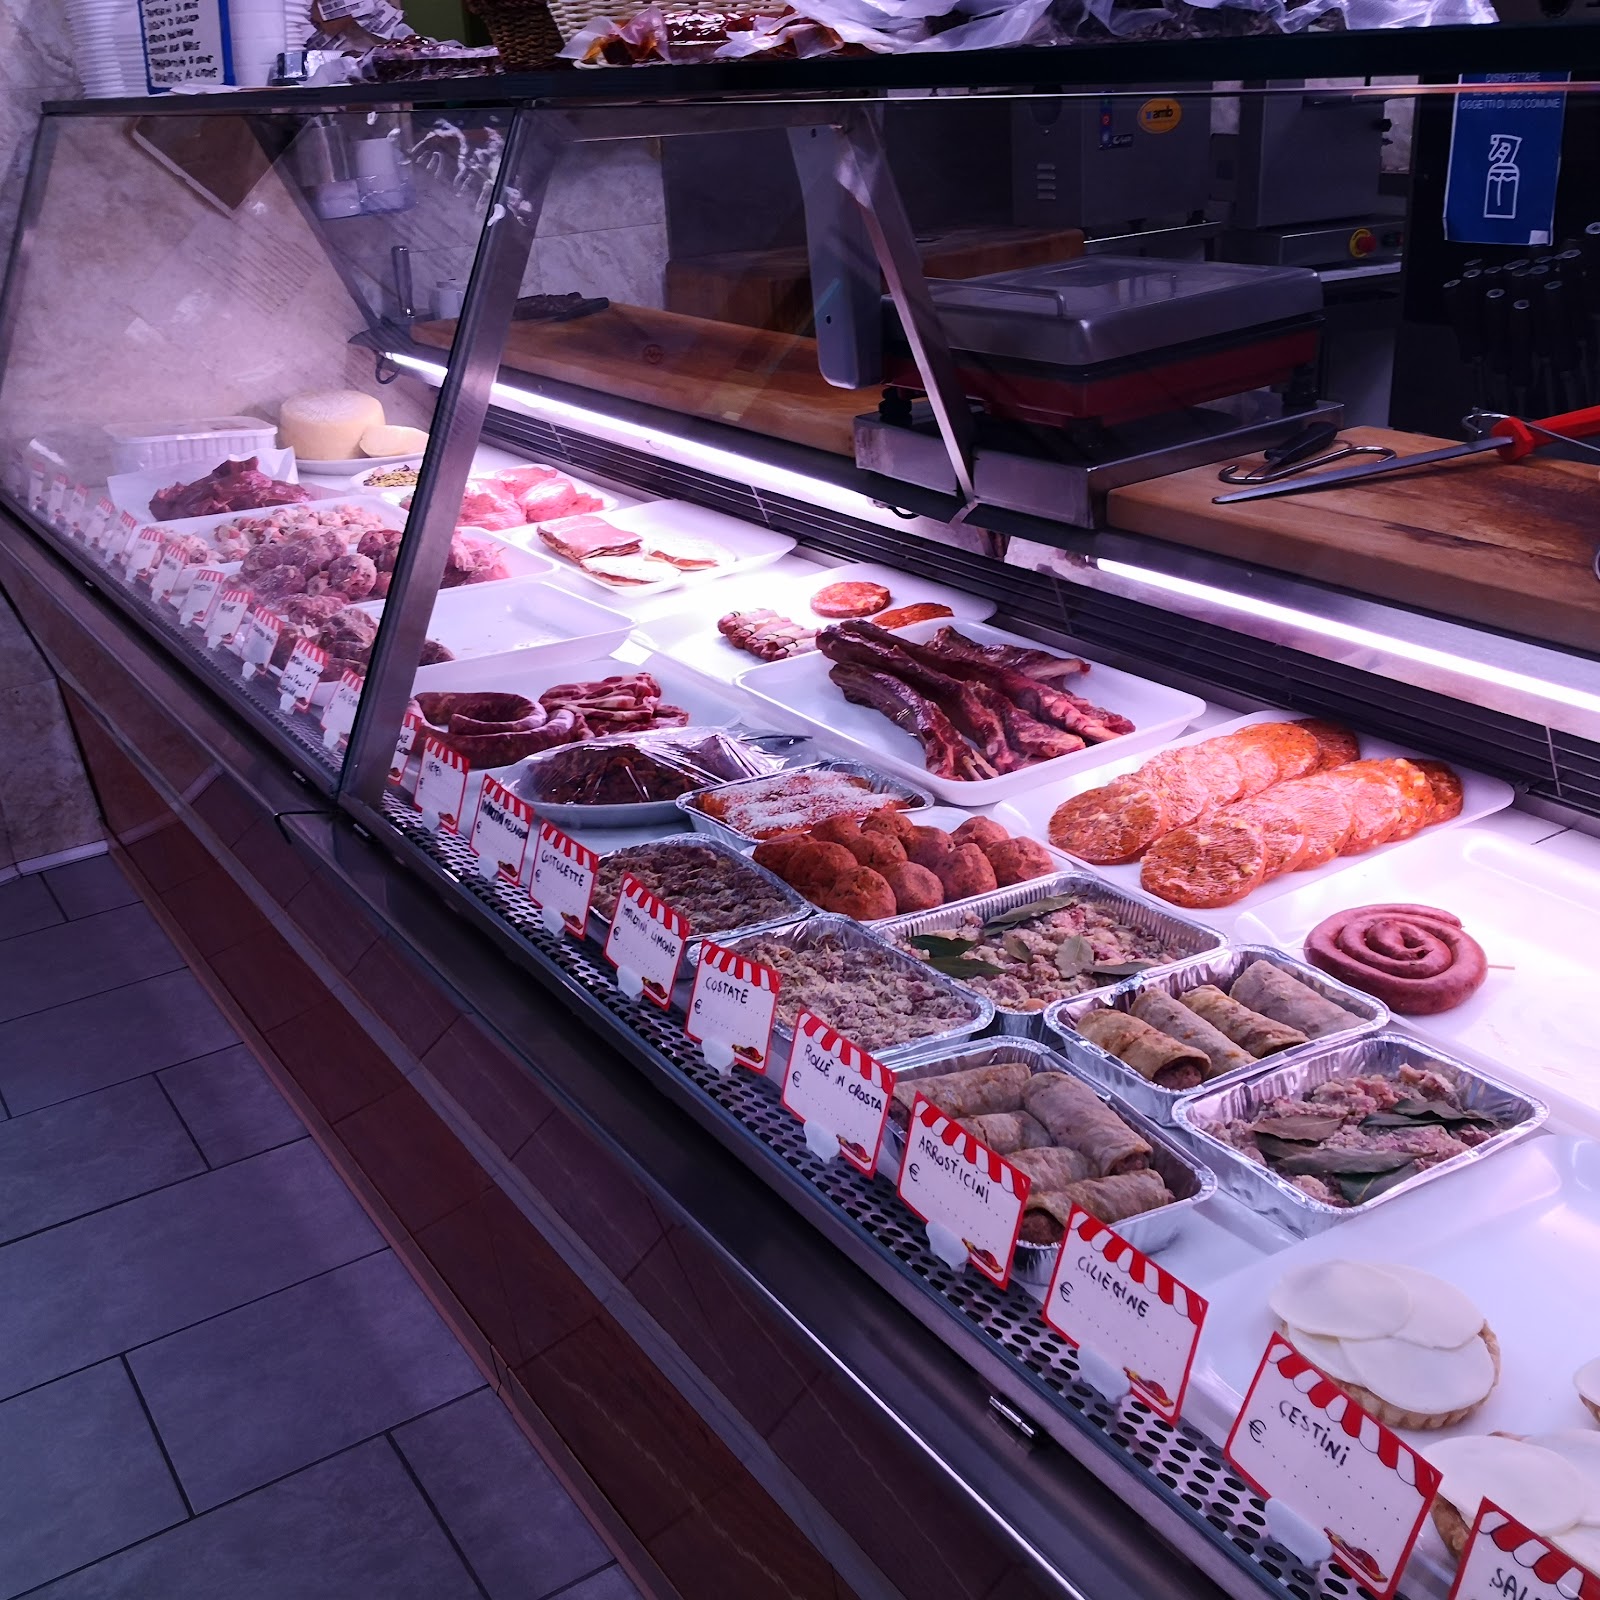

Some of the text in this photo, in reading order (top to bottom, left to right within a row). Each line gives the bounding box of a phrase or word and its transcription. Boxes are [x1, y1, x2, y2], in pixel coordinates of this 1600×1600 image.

[1461, 98, 1560, 110] OGGETTI DI USO COMUNE
[613, 926, 622, 941] €
[650, 928, 677, 958] LIMONE
[705, 976, 749, 1004] COSTATE
[694, 998, 703, 1015] €
[792, 1070, 802, 1088] €
[848, 1083, 882, 1113] CROSTA
[908, 1163, 920, 1182] €
[918, 1135, 991, 1204] ARROSTICINI
[1059, 1281, 1074, 1303] €
[1077, 1255, 1150, 1318] CILIEGINE
[1249, 1419, 1267, 1444] €
[1279, 1399, 1351, 1467] CESTINI
